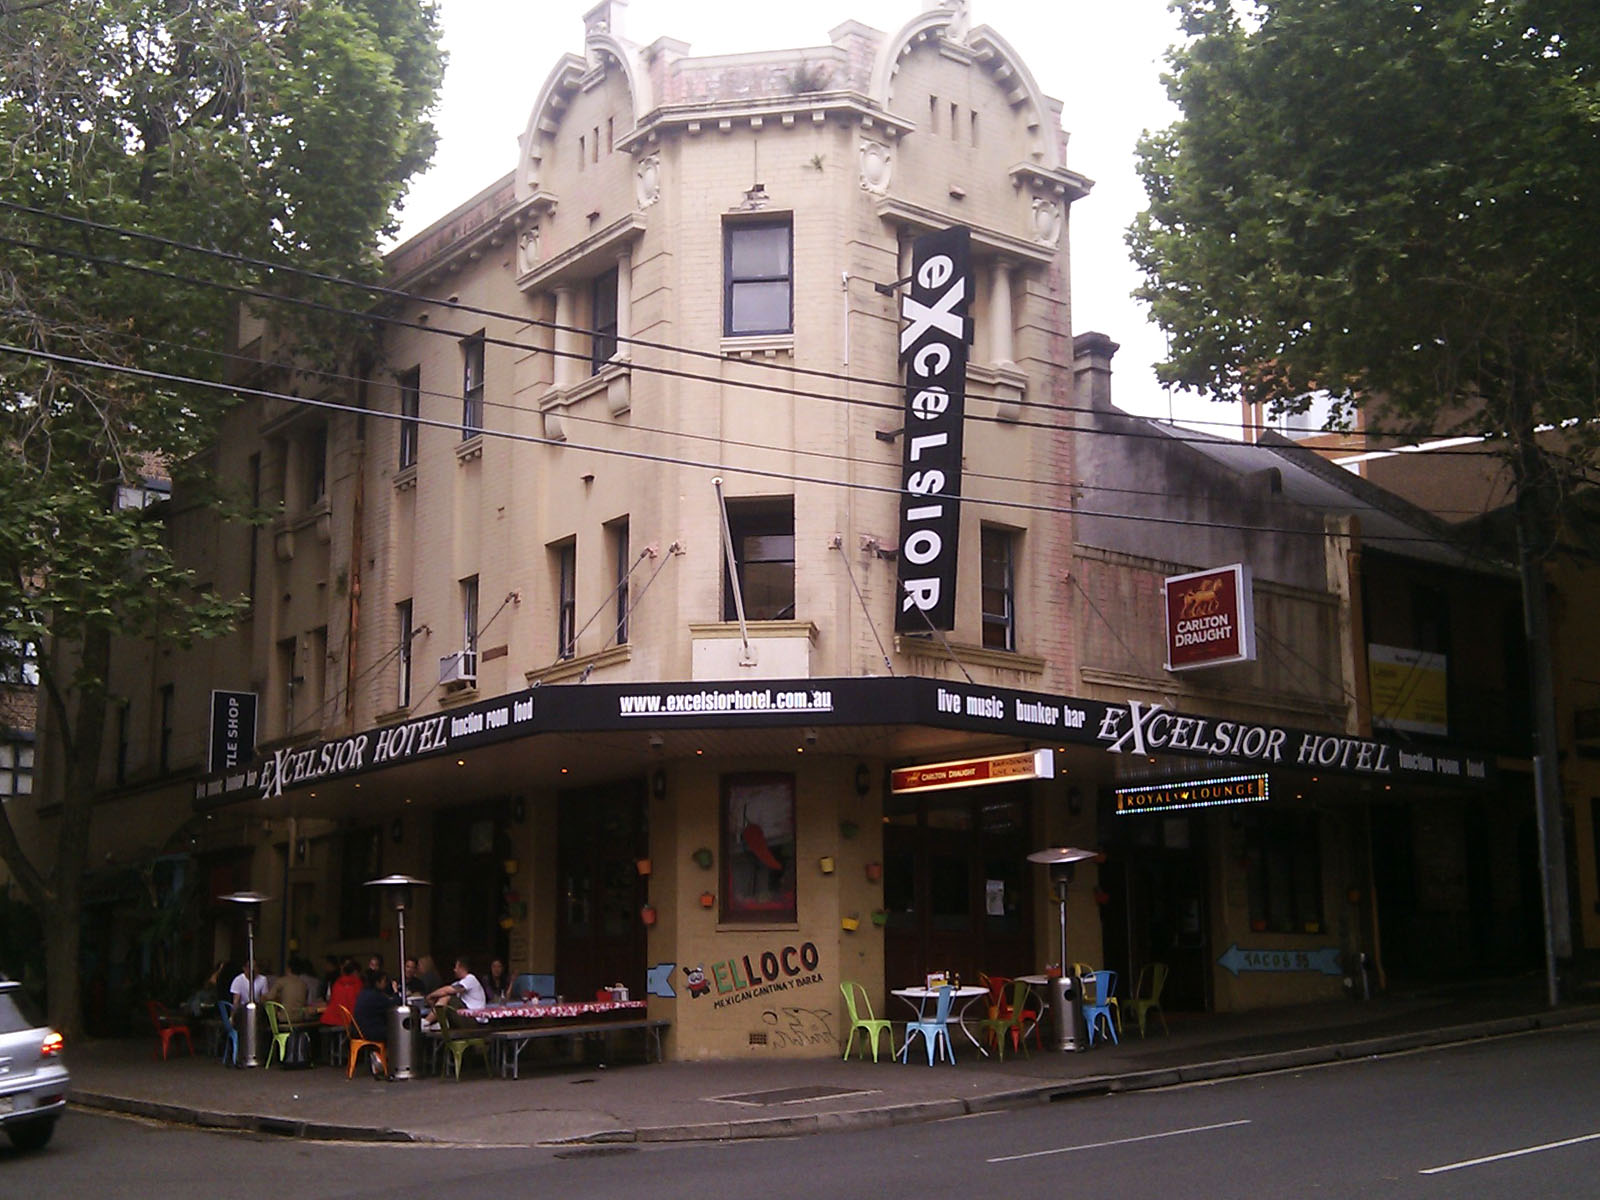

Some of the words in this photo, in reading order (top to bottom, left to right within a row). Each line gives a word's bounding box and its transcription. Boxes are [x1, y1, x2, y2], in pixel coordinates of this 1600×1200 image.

[1175, 626, 1233, 648] DRAUGHT
[1177, 613, 1229, 633] CARLTON
[227, 697, 240, 738] SHOP
[451, 711, 484, 738] function
[485, 707, 509, 730] room
[514, 697, 534, 724] food
[619, 690, 832, 713] www.excelsiorhotel.com.au
[937, 688, 961, 713] live
[966, 695, 1004, 719] music
[1016, 699, 1059, 726] bunker
[1064, 705, 1086, 729] bar
[373, 715, 450, 762] HOTEL
[1297, 734, 1391, 773] HOTEL
[1127, 791, 1171, 807] ROYAL
[1192, 783, 1255, 801] LOUNGE
[743, 941, 819, 988] LOCO
[1244, 952, 1290, 969] TACOS
[714, 991, 752, 1010] MEXICAN
[752, 981, 787, 998] CANTINA
[787, 979, 795, 989] Y
[796, 973, 824, 988] BARRA
